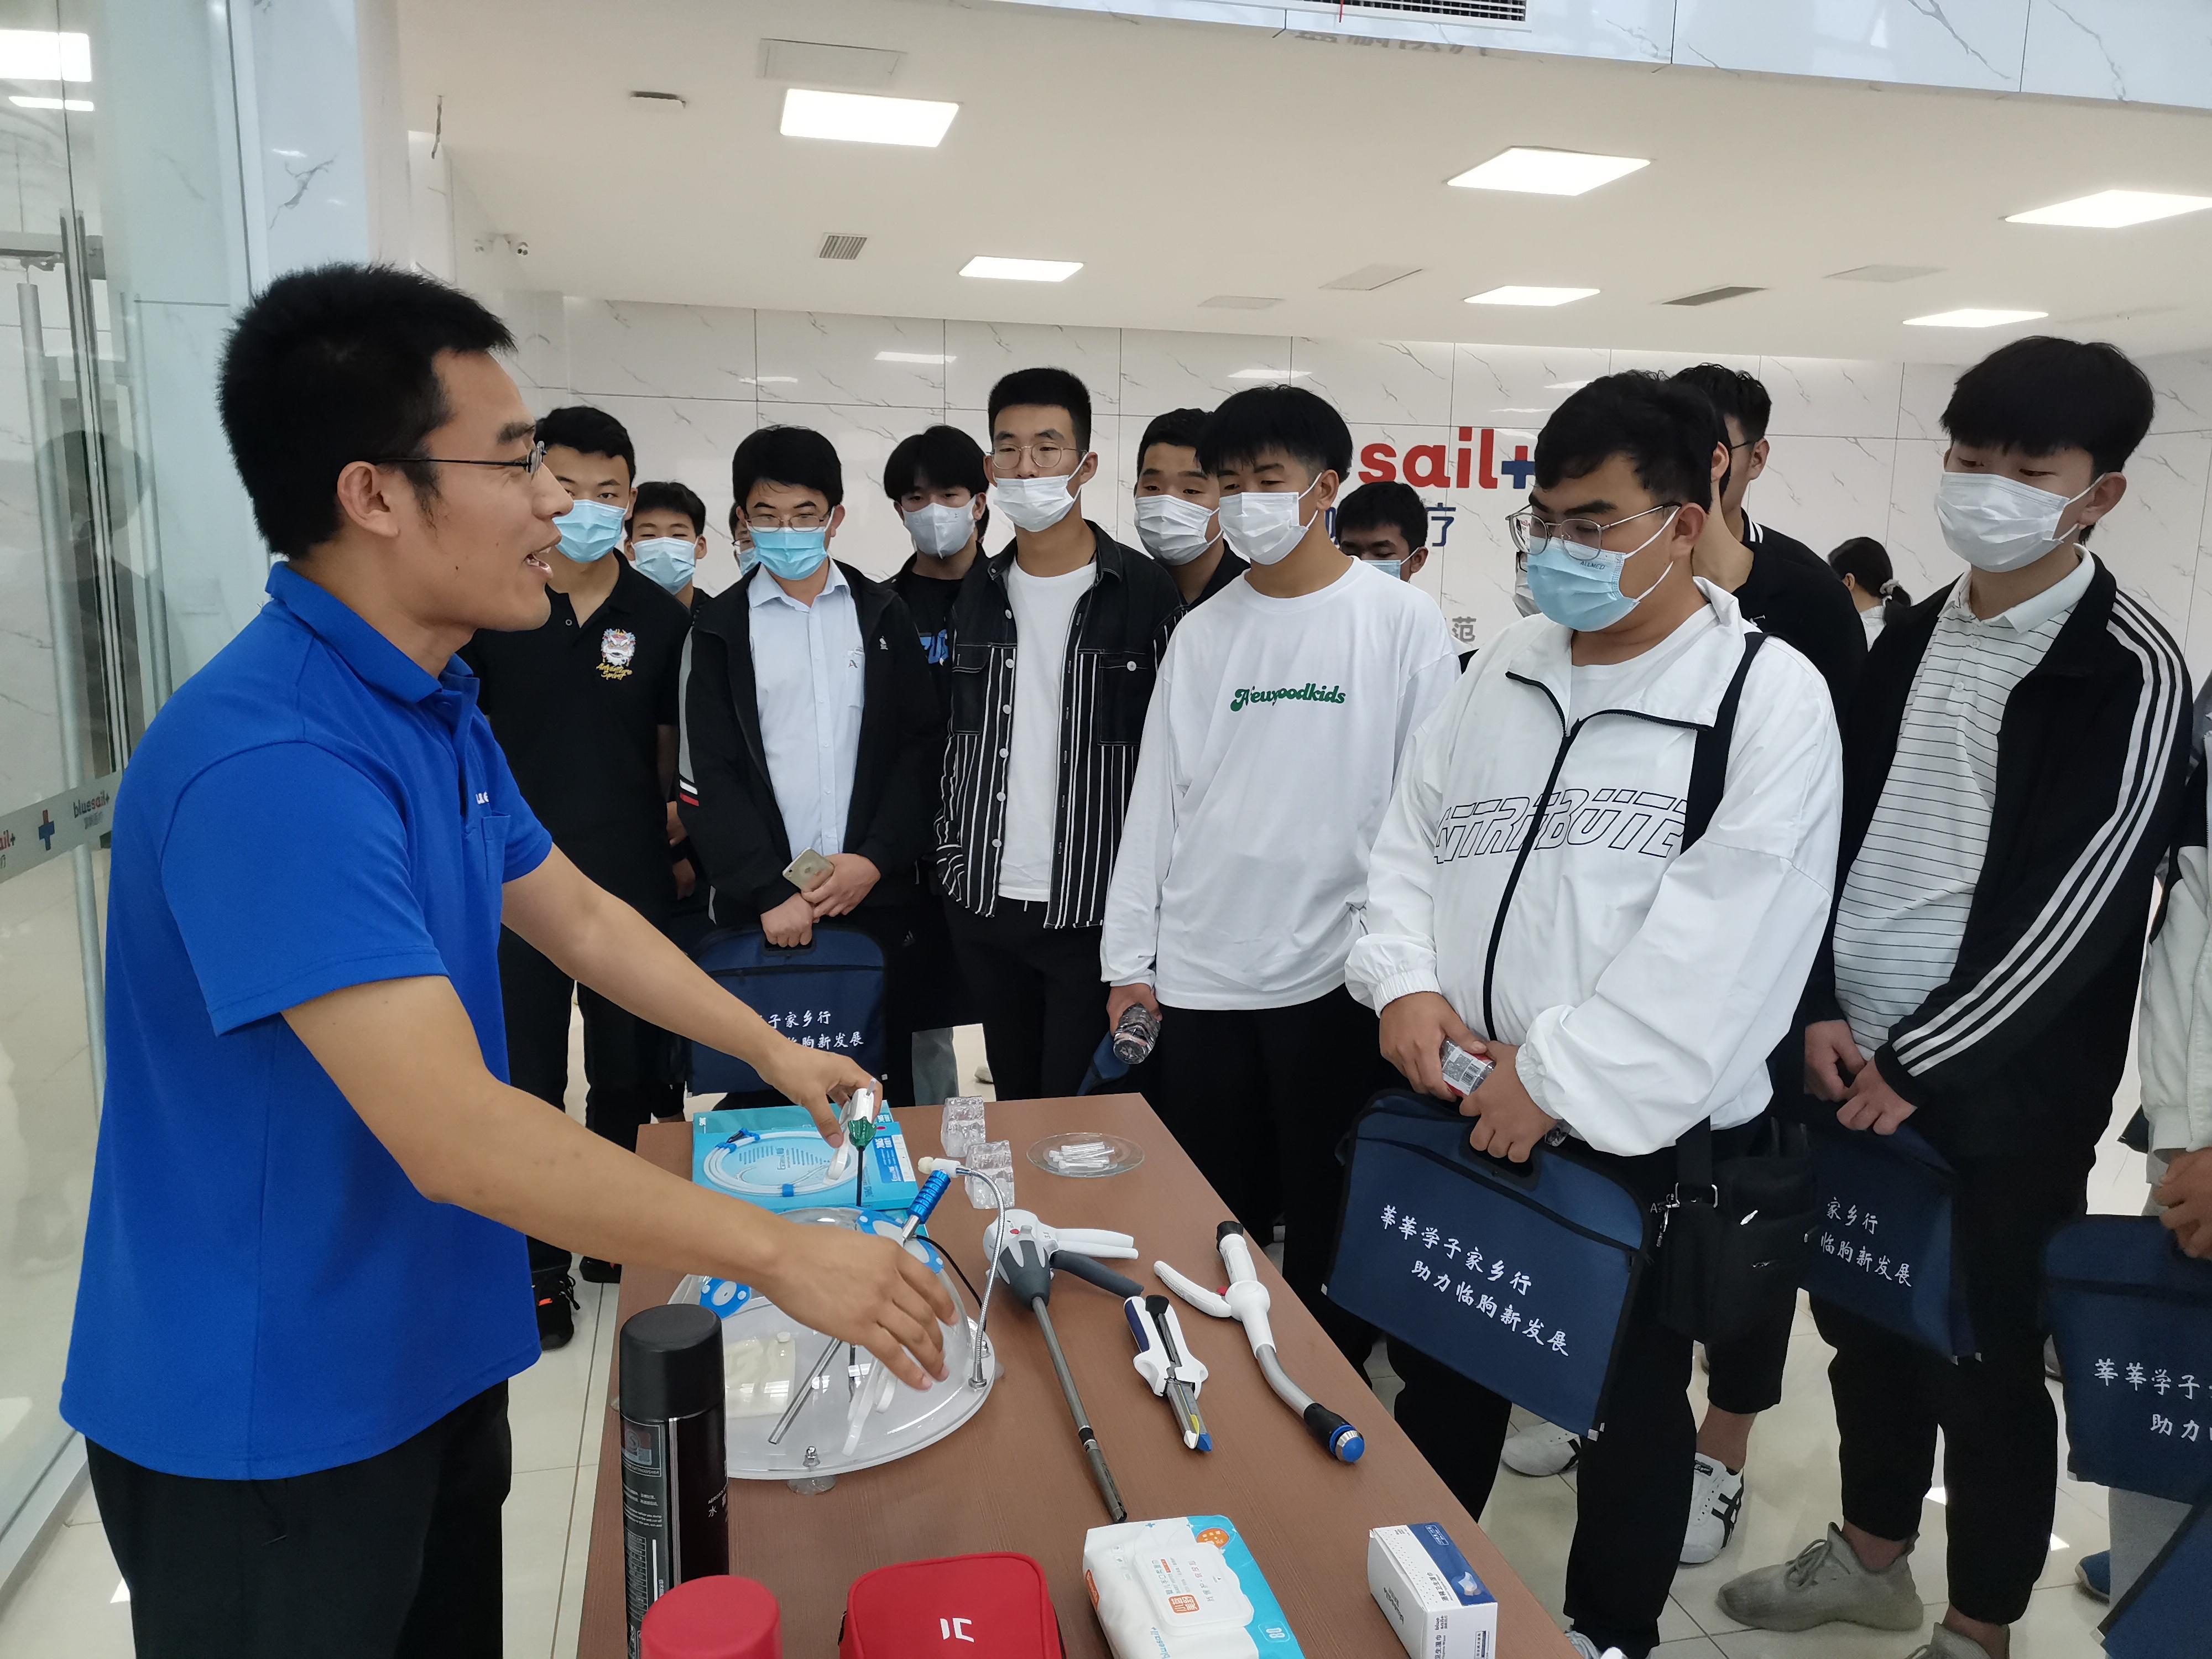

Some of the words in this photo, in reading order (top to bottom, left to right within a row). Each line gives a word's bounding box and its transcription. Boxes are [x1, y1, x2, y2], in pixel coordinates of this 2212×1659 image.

[1452, 616, 1477, 643] 范
[759, 1010, 831, 1029] 子家乡行
[787, 1031, 864, 1050] 朐新发展
[1826, 1196, 1879, 1235] 家乡行
[1380, 1204, 1532, 1296] 莘莘学子家乡行
[1820, 1232, 1912, 1287] 临朐新发展
[1411, 1260, 1569, 1357] 助力临朐新发展
[2094, 1358, 2212, 1400] 莘莘学子
[2150, 1413, 2212, 1442] 助力
